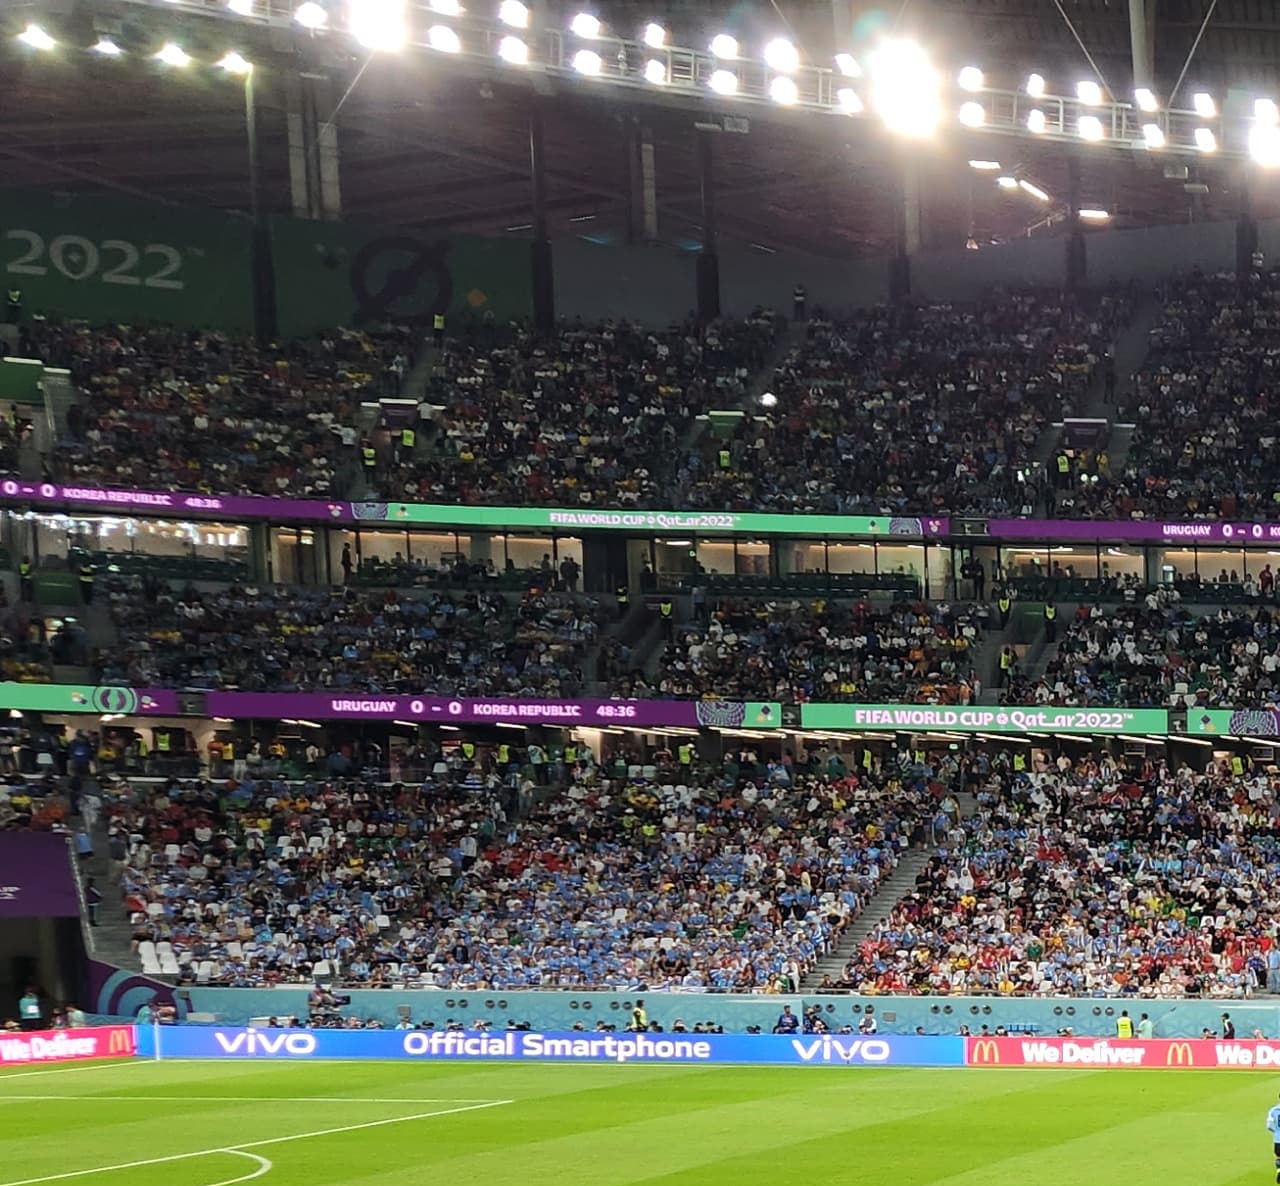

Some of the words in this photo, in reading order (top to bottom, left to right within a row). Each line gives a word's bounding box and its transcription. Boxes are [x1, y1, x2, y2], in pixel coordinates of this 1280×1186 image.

[6, 229, 185, 290] 2022
[41, 483, 57, 498] 0
[62, 487, 107, 502] KOREA
[107, 490, 172, 506] REPUBLIC
[550, 512, 576, 525] FIFA
[577, 512, 621, 526] WORLD
[622, 513, 646, 526] CUP
[1163, 524, 1212, 536] URUGUAY
[1222, 524, 1233, 537] 0
[1252, 524, 1263, 538] 0
[332, 700, 396, 712] URUGUAY
[411, 700, 424, 714] 0
[448, 701, 463, 715] 0
[473, 703, 517, 716] KOREA
[518, 704, 581, 717] REPUBLIC
[596, 705, 637, 718] 48:36
[855, 709, 893, 725] FIFA
[894, 710, 957, 726] WORLD
[959, 712, 993, 726] CUP
[1, 1040, 31, 1061] We
[33, 1035, 97, 1058] Deliver
[215, 1028, 316, 1054] vivo
[403, 1030, 514, 1057] Official
[522, 1033, 711, 1061] Smartphone
[792, 1036, 890, 1061] vivo
[1022, 1042, 1059, 1062] We
[1062, 1042, 1145, 1065] Deliver
[1216, 1044, 1253, 1064] We
